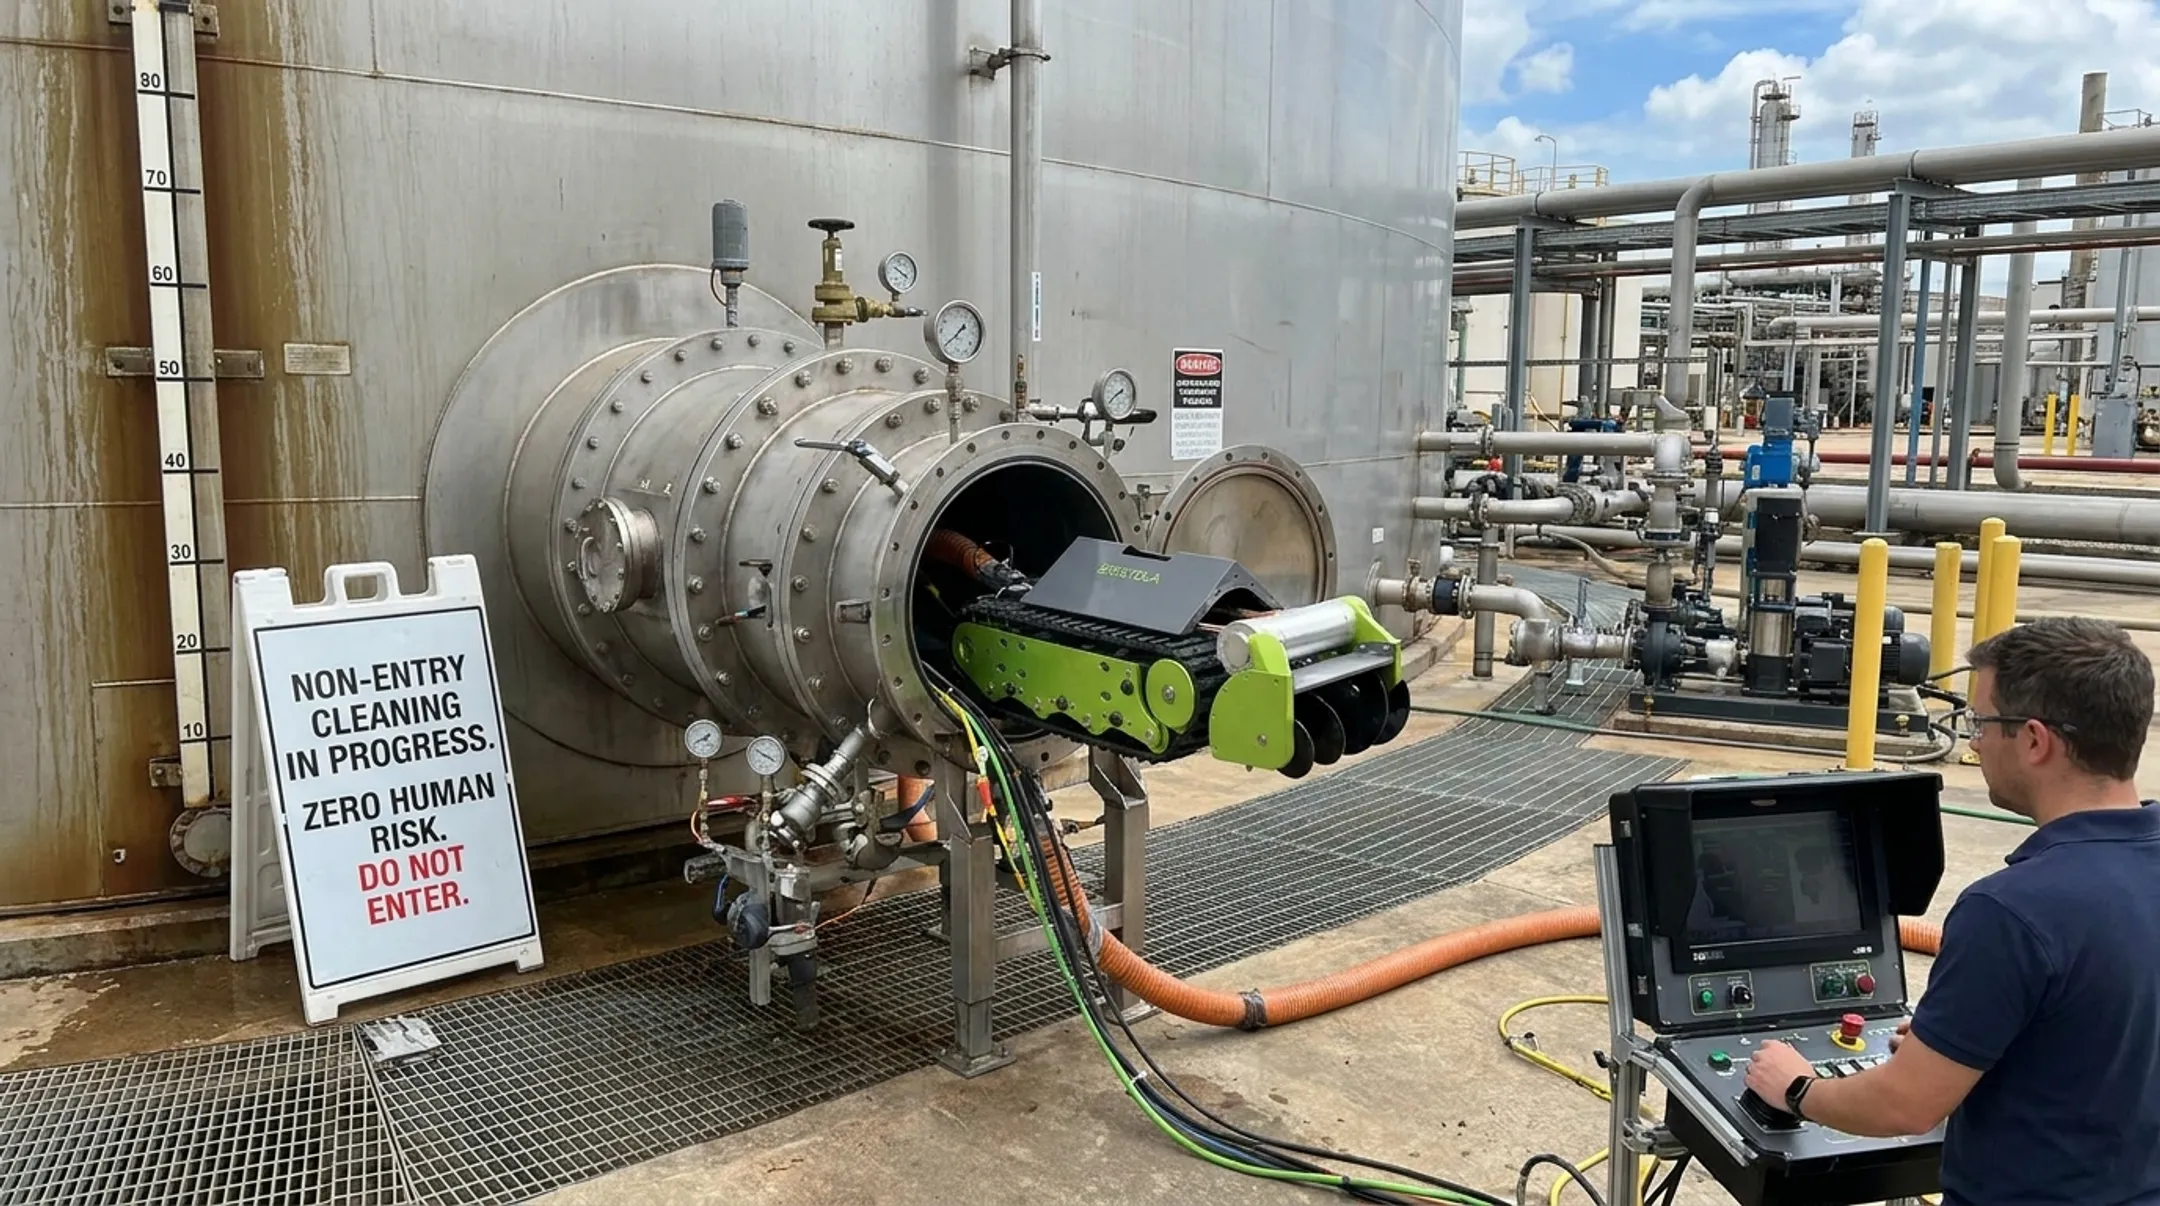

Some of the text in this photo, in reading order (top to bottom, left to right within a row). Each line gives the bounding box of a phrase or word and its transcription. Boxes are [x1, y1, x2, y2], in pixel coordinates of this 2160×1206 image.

[140, 71, 161, 89] 80
[145, 169, 167, 186] 70
[152, 265, 173, 282] 60
[159, 360, 180, 376] 50
[164, 452, 186, 468] 40
[170, 543, 192, 560] 30
[176, 633, 198, 650] 20
[290, 653, 465, 703] NON-ENTRY
[311, 691, 462, 739] CLEANING
[183, 721, 204, 738] 10
[285, 723, 496, 782] IN PROGRESS.
[302, 771, 496, 832] ZERO HUMAN
[370, 815, 448, 854] RISK.
[358, 844, 465, 894] DO NOT
[367, 880, 469, 926] ENTER.
